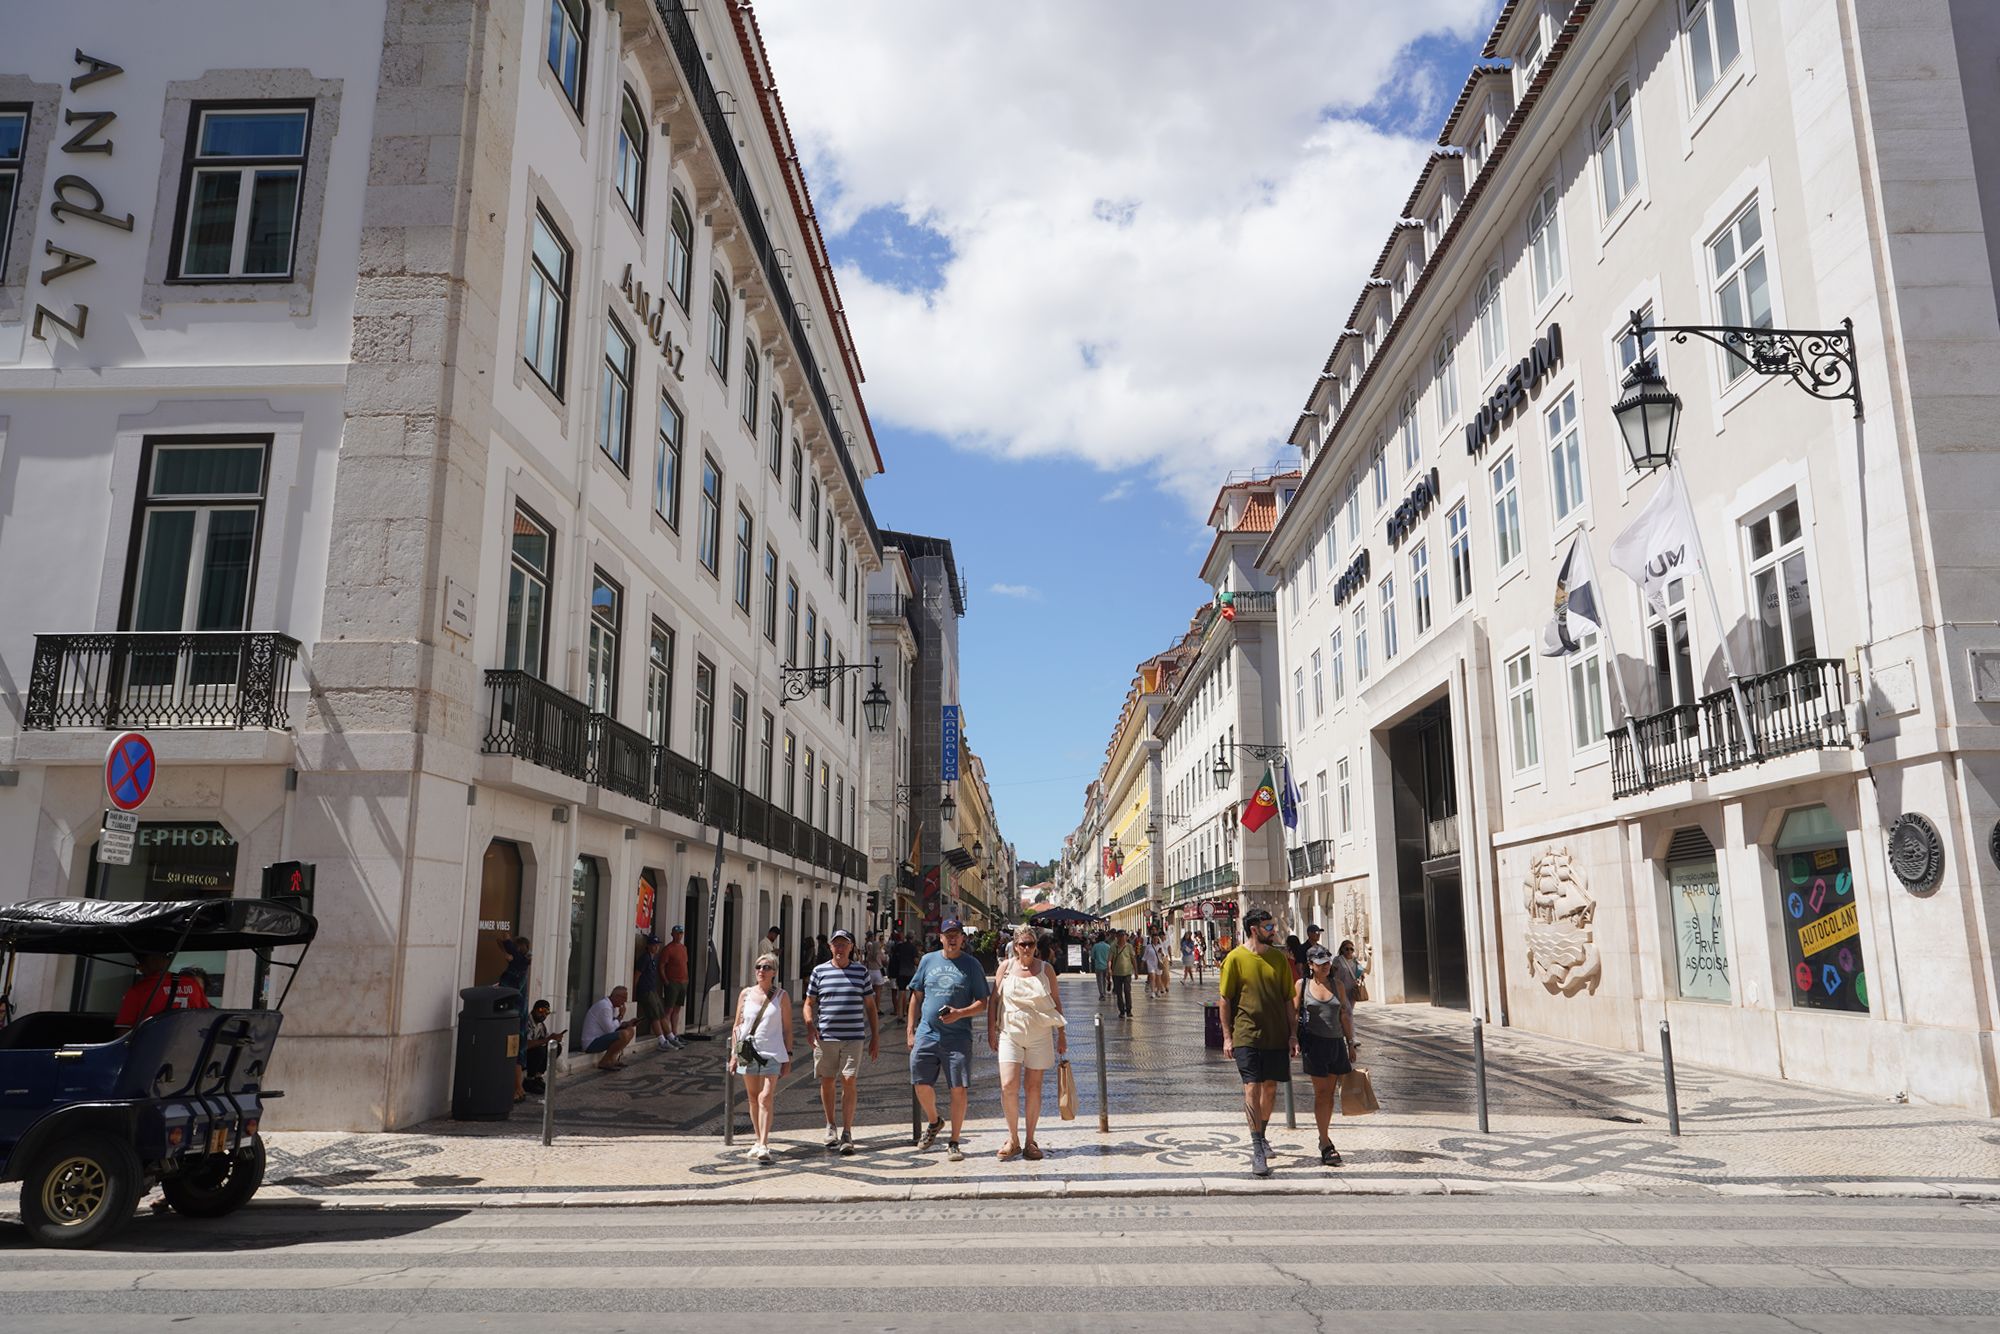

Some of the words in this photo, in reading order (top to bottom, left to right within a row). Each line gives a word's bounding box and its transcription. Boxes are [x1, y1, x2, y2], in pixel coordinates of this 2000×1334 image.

[1465, 322, 1563, 456] MUSEUM
[1386, 466, 1438, 546] DESIGN
[139, 829, 236, 846] EPHOR
[1682, 884, 1706, 897] PARA
[1801, 904, 1859, 947] AUTOCOLANT
[1699, 957, 1728, 970] COISA
